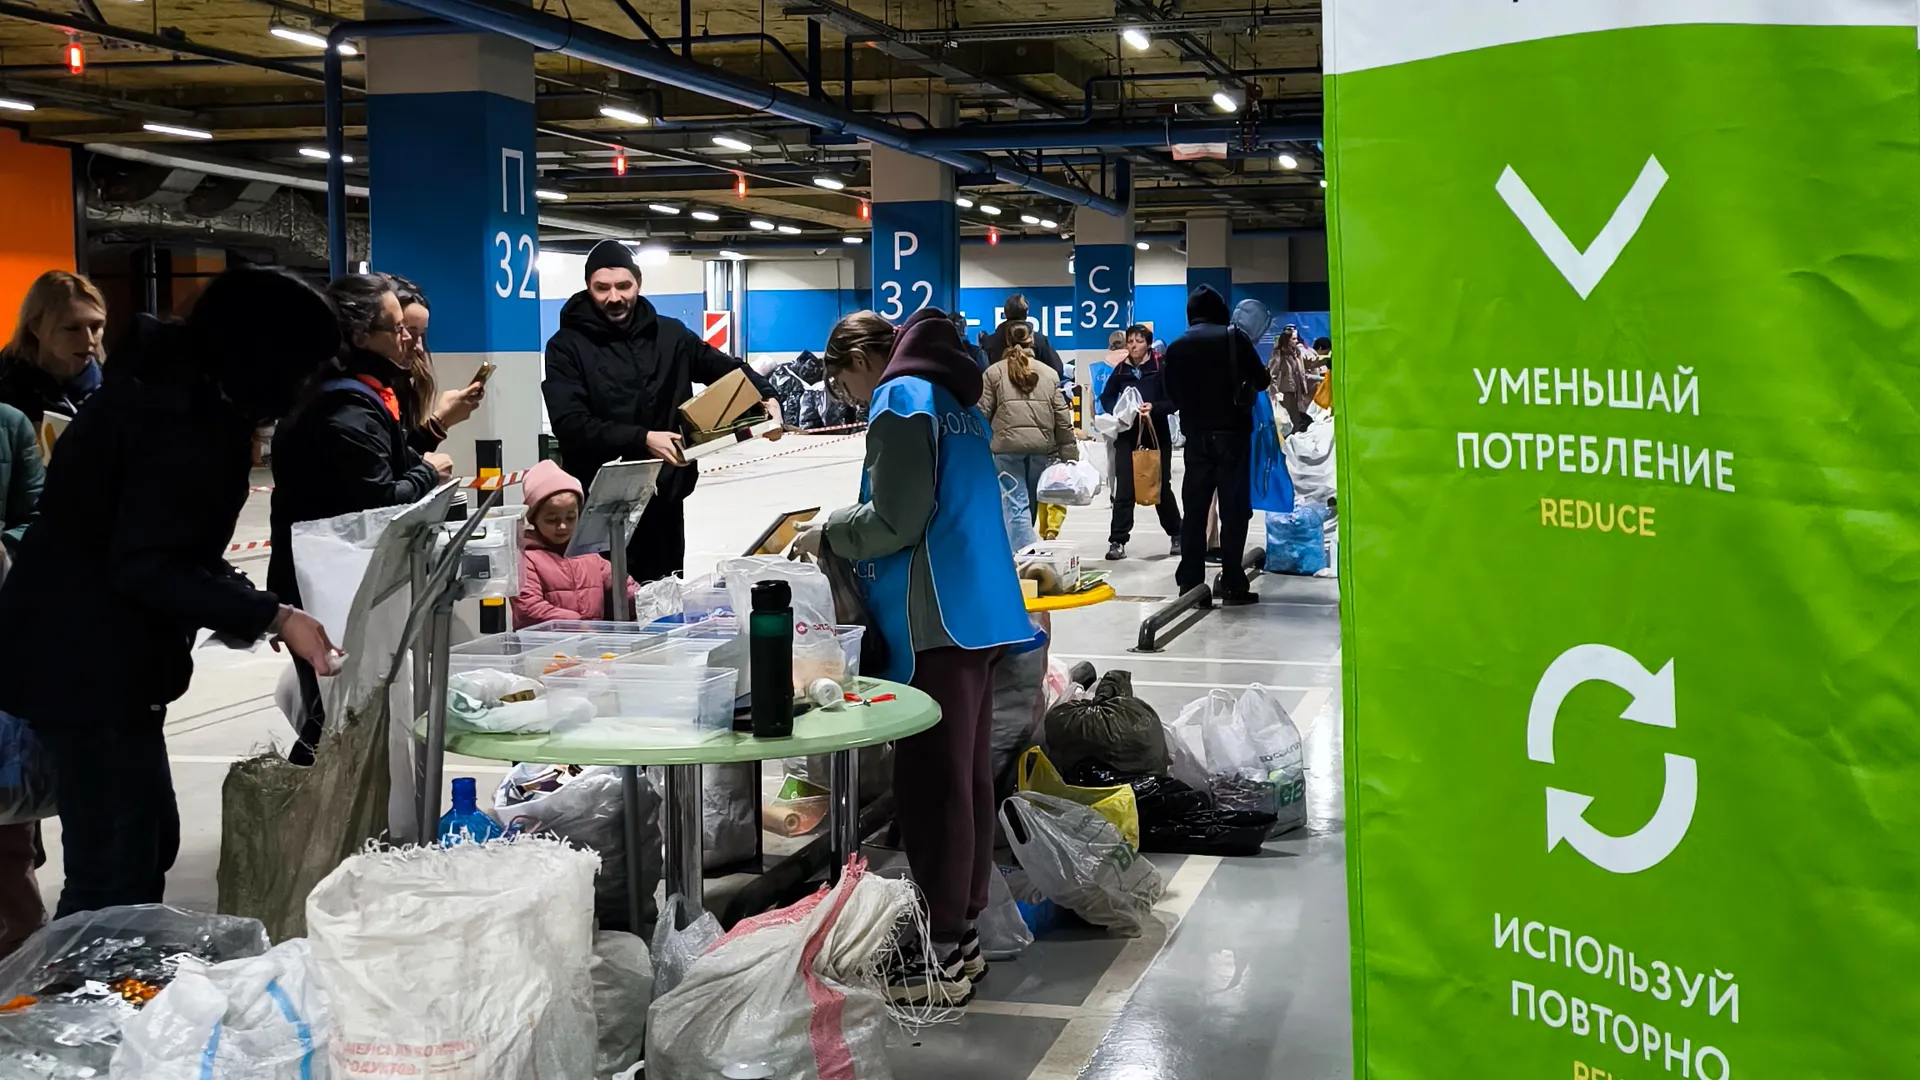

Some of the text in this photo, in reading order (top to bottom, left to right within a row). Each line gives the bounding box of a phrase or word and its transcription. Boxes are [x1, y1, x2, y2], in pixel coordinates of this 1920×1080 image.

[502, 147, 525, 215] П
[495, 231, 536, 298] 32
[894, 231, 918, 270] Р
[880, 281, 932, 320] 32
[1089, 265, 1111, 293] С
[1080, 301, 1120, 329] 32
[1474, 366, 1699, 416] УМЕНЬШАЙ
[1457, 432, 1735, 492] ПОТРЕБЛЕНИЕ
[1540, 497, 1656, 537] REDUCE
[1494, 913, 1739, 1024] ИСПОЛЬЗУЙ
[1511, 980, 1730, 1080] ПОВТОРНО
